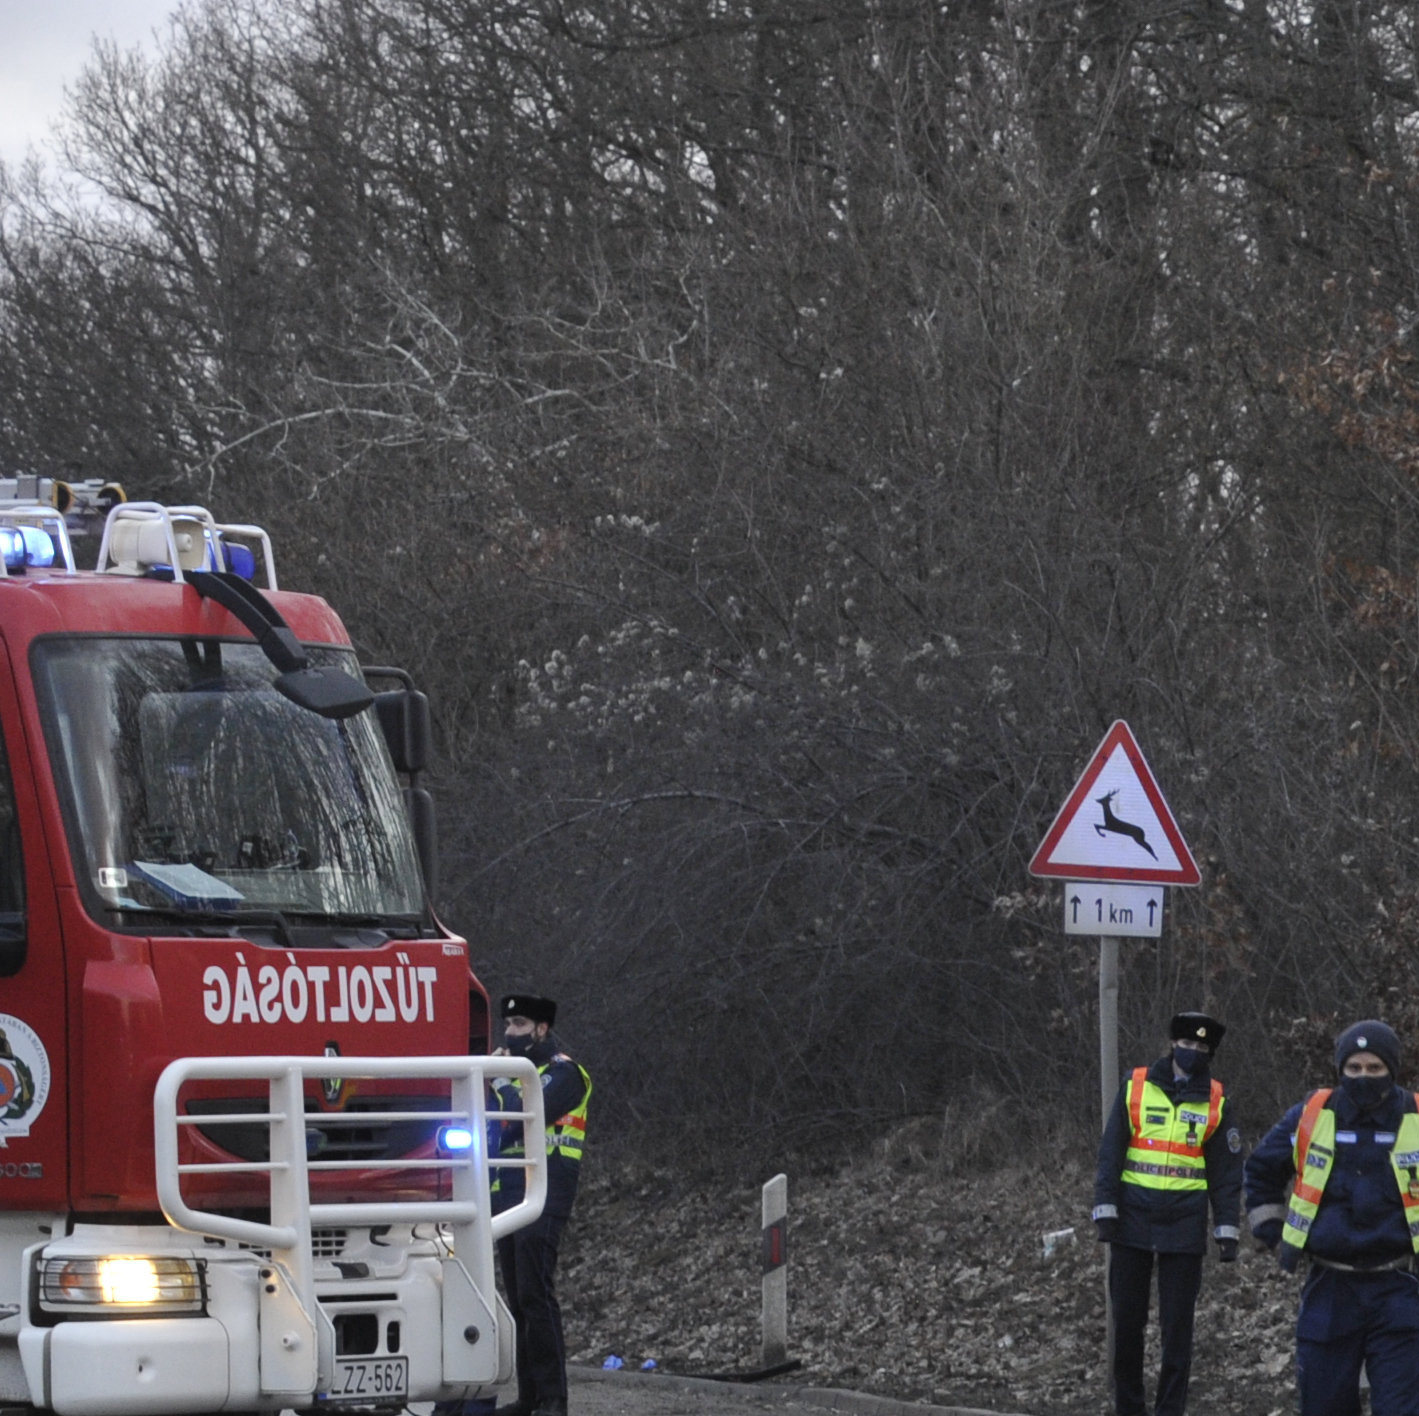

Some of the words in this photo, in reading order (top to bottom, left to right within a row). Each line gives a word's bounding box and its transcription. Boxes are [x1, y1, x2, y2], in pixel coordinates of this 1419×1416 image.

[1095, 898, 1103, 923] 1
[1109, 902, 1133, 924] km
[1181, 1110, 1206, 1124] POLICE
